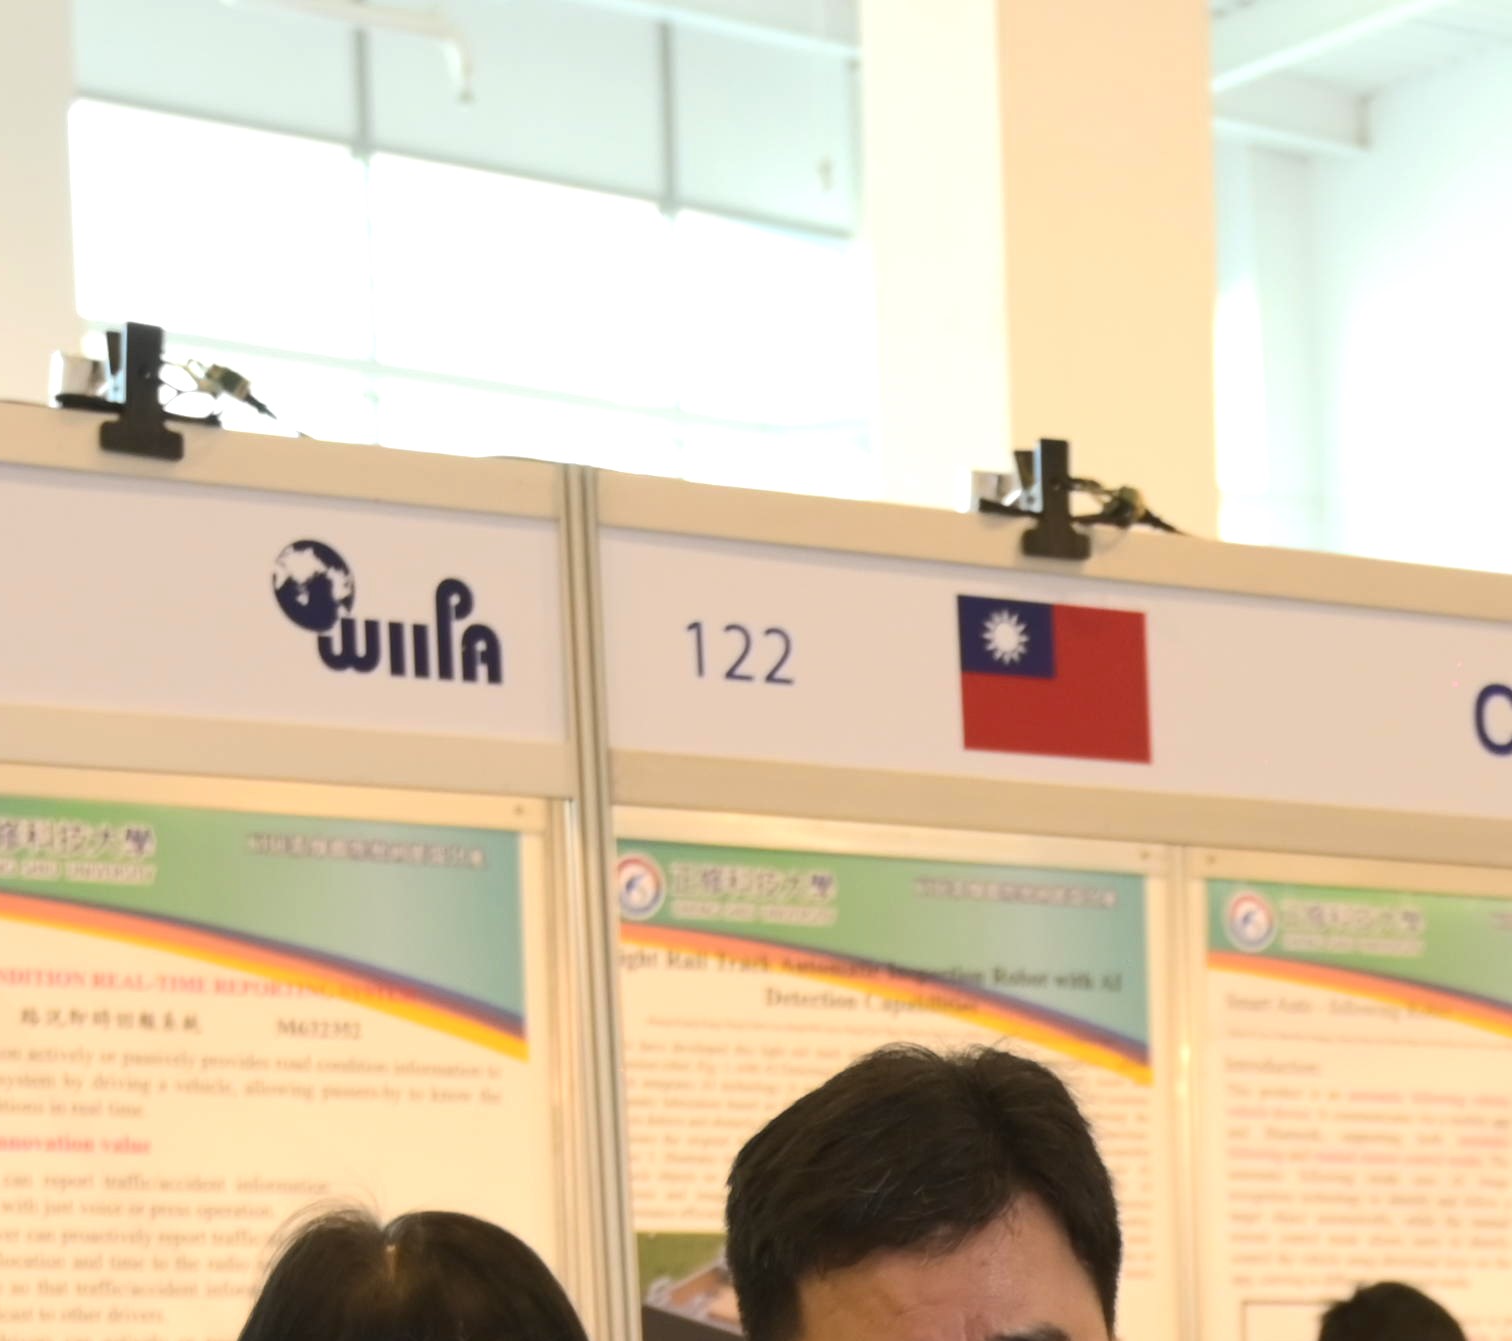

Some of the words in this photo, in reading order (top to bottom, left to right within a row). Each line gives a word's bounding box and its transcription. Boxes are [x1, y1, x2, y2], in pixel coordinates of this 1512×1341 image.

[685, 620, 795, 685] 122
[1054, 971, 1096, 991] with
[766, 988, 858, 1011] Detection
